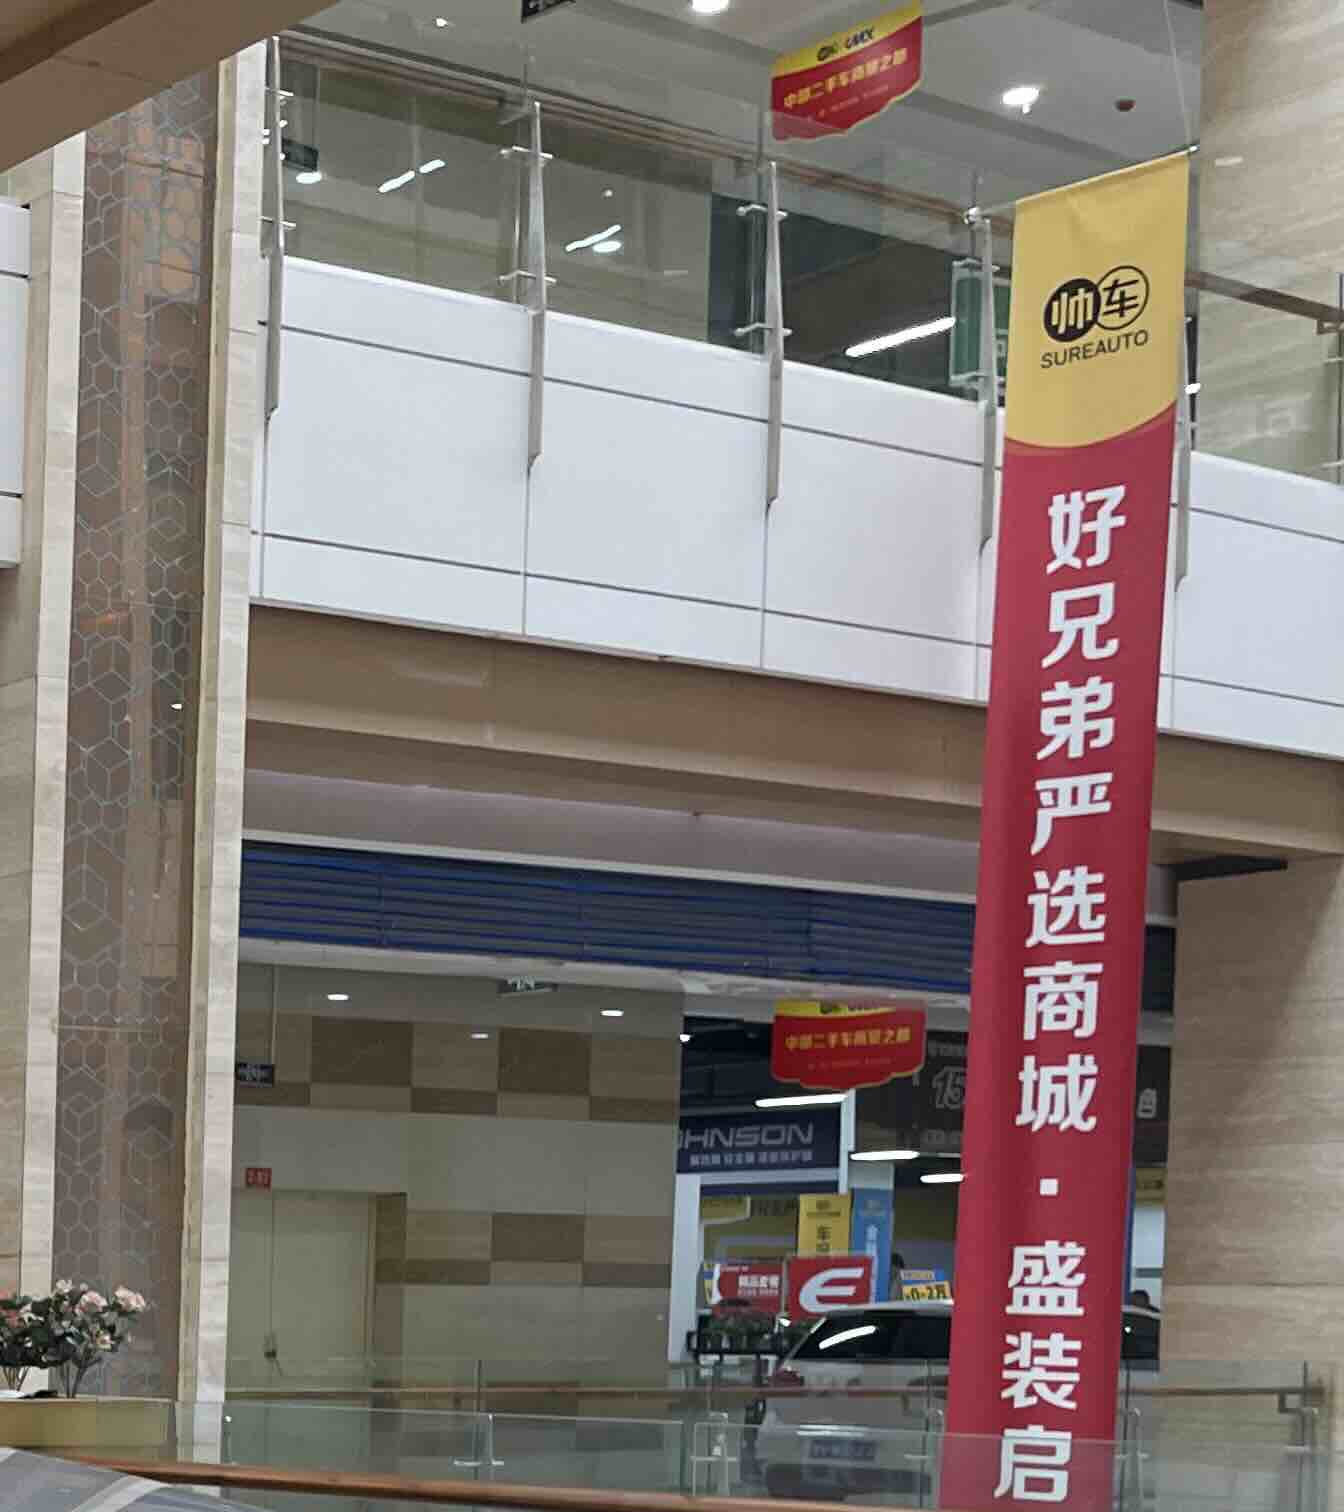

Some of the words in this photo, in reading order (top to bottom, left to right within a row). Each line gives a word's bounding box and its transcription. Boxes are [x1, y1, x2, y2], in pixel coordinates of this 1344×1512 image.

[1044, 265, 1149, 343] 帅车
[1040, 329, 1149, 369] SUREAUTO
[678, 1123, 815, 1150] HNSON
